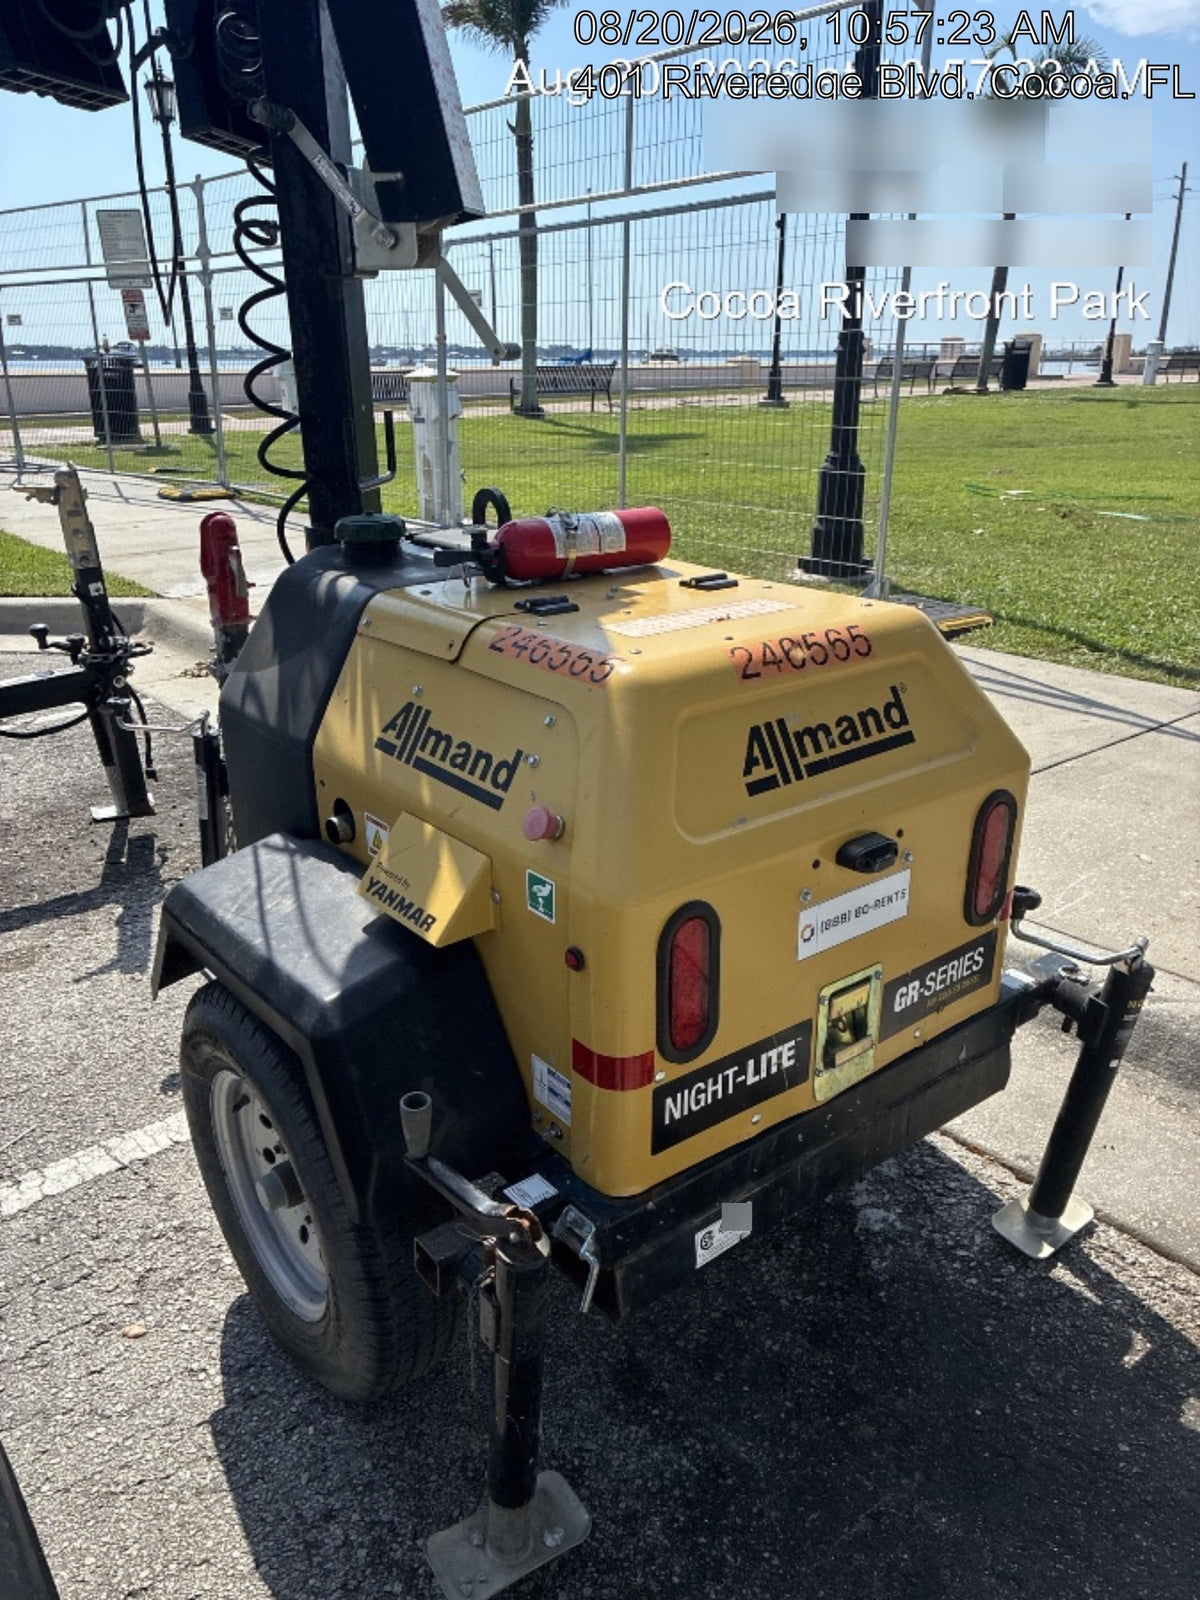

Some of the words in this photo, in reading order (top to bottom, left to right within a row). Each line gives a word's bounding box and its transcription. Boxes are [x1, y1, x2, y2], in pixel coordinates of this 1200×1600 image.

[379, 701, 524, 796] Allmand
[742, 685, 910, 787] Allmand
[365, 875, 437, 933] YANMAR
[893, 946, 985, 1013] GR-SERIES
[663, 1039, 796, 1127] NIGHT-LITE
